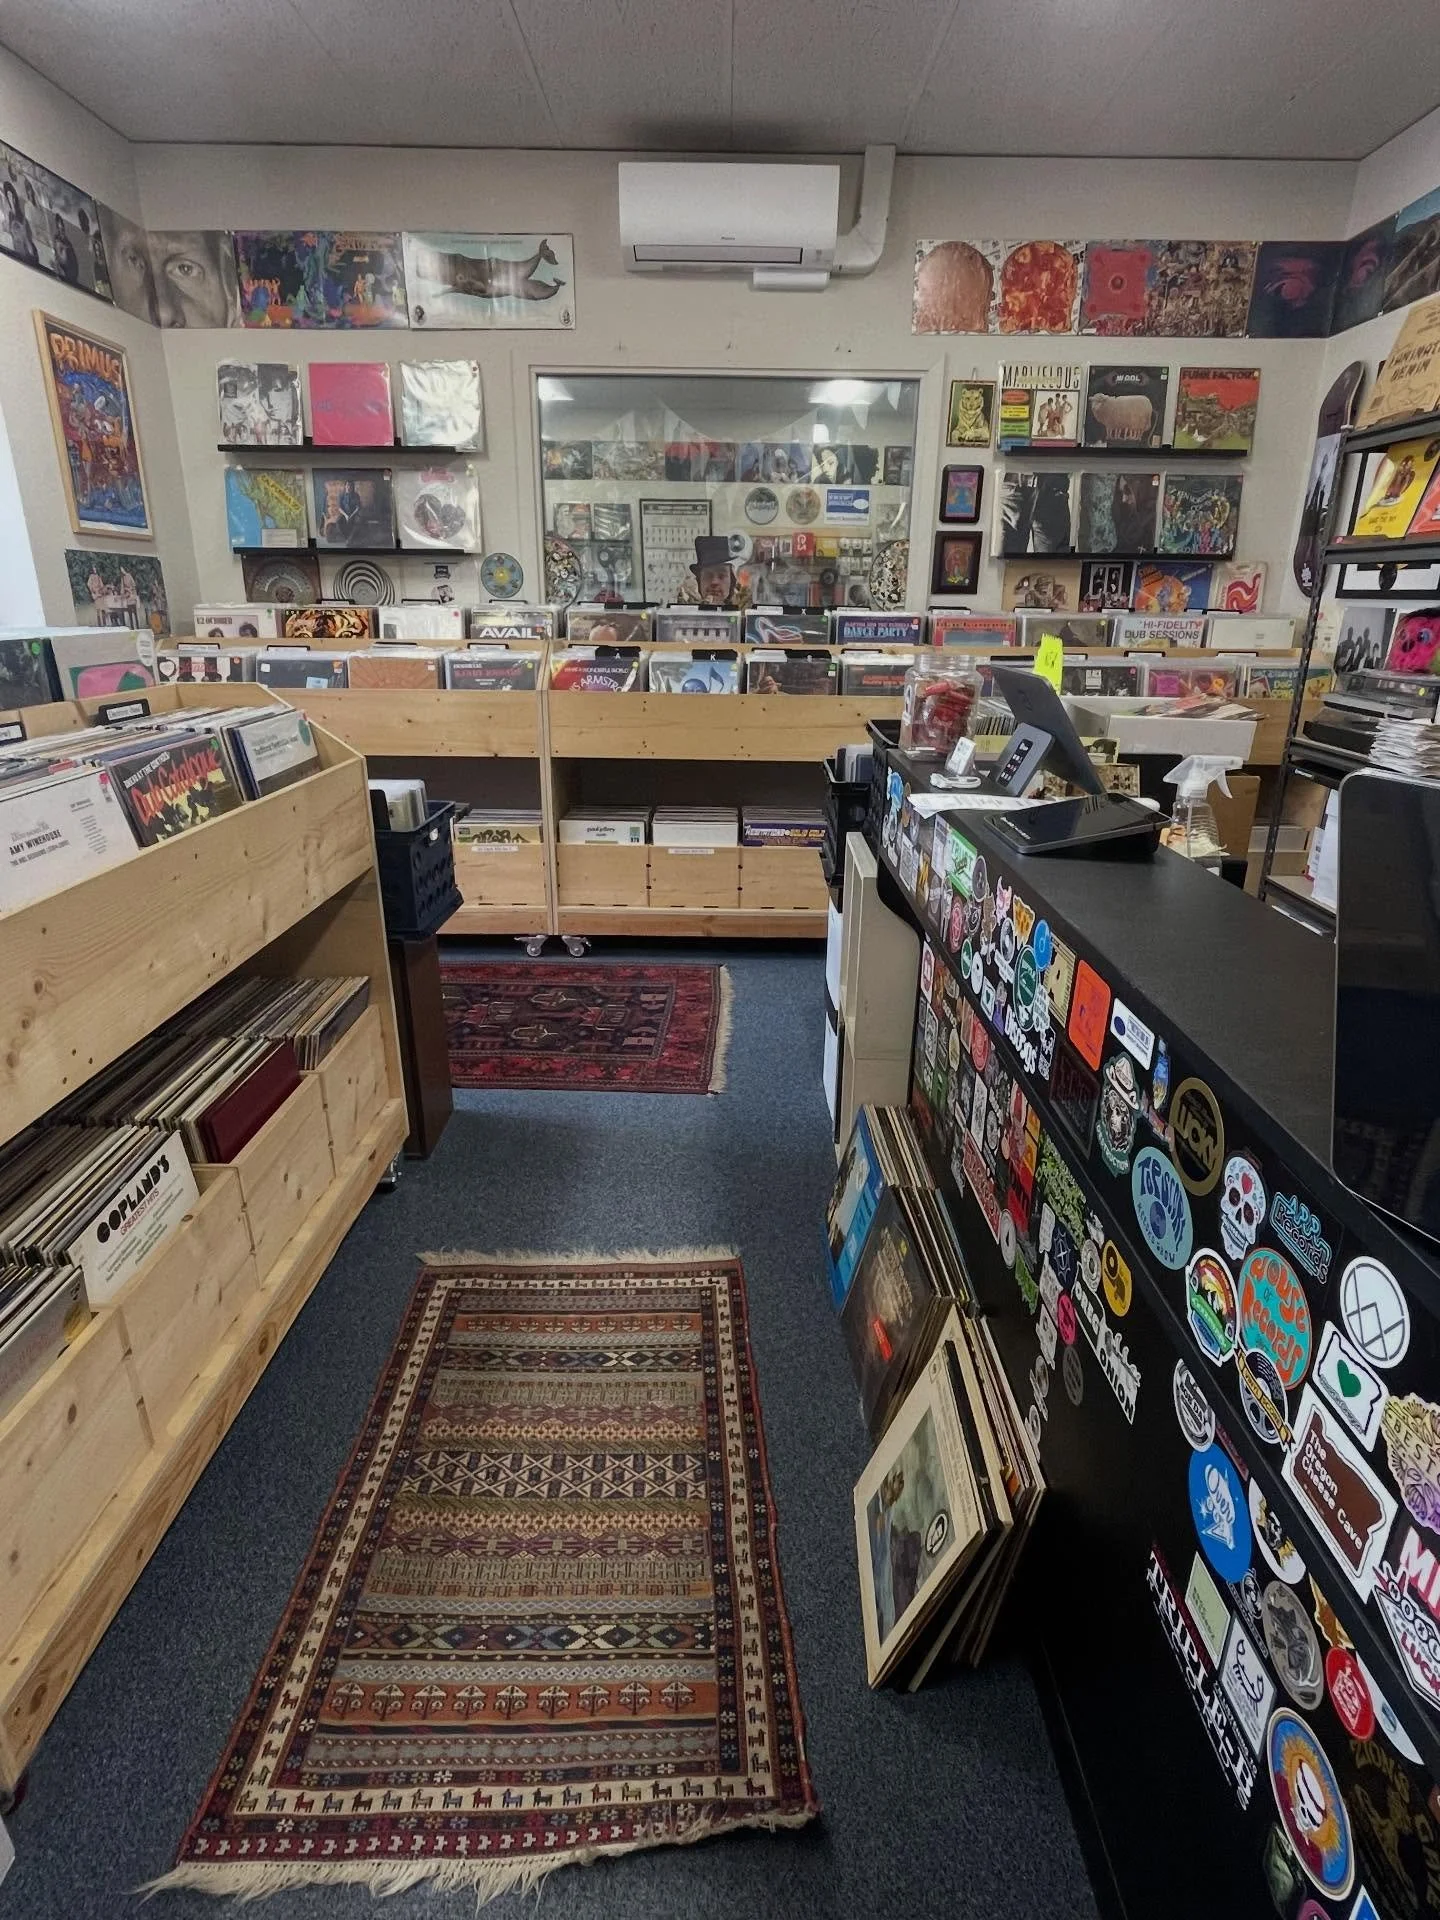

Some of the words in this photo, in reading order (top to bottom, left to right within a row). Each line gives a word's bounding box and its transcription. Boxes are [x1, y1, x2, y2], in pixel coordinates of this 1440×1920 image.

[50, 332, 122, 389] PRIMUS
[480, 627, 540, 639] AVAIL
[844, 626, 875, 638] DANCE
[877, 626, 908, 638] PARTY
[1124, 630, 1146, 639] DUB
[1149, 630, 1199, 640] SESSIONS
[1143, 620, 1202, 629] HI-FIDELITY
[9, 844, 25, 856] AMY
[26, 829, 62, 849] WINEHOUSE
[120, 1202, 148, 1236] GREATEST
[146, 1188, 160, 1207] HITS
[1309, 1428, 1327, 1461] The
[1394, 1418, 1436, 1475] BEST
[1304, 1443, 1339, 1497] Oregon
[1301, 1457, 1336, 1513] Cheese
[1337, 1509, 1363, 1552] Cave
[1150, 1551, 1254, 1799] TRIPLE-B
